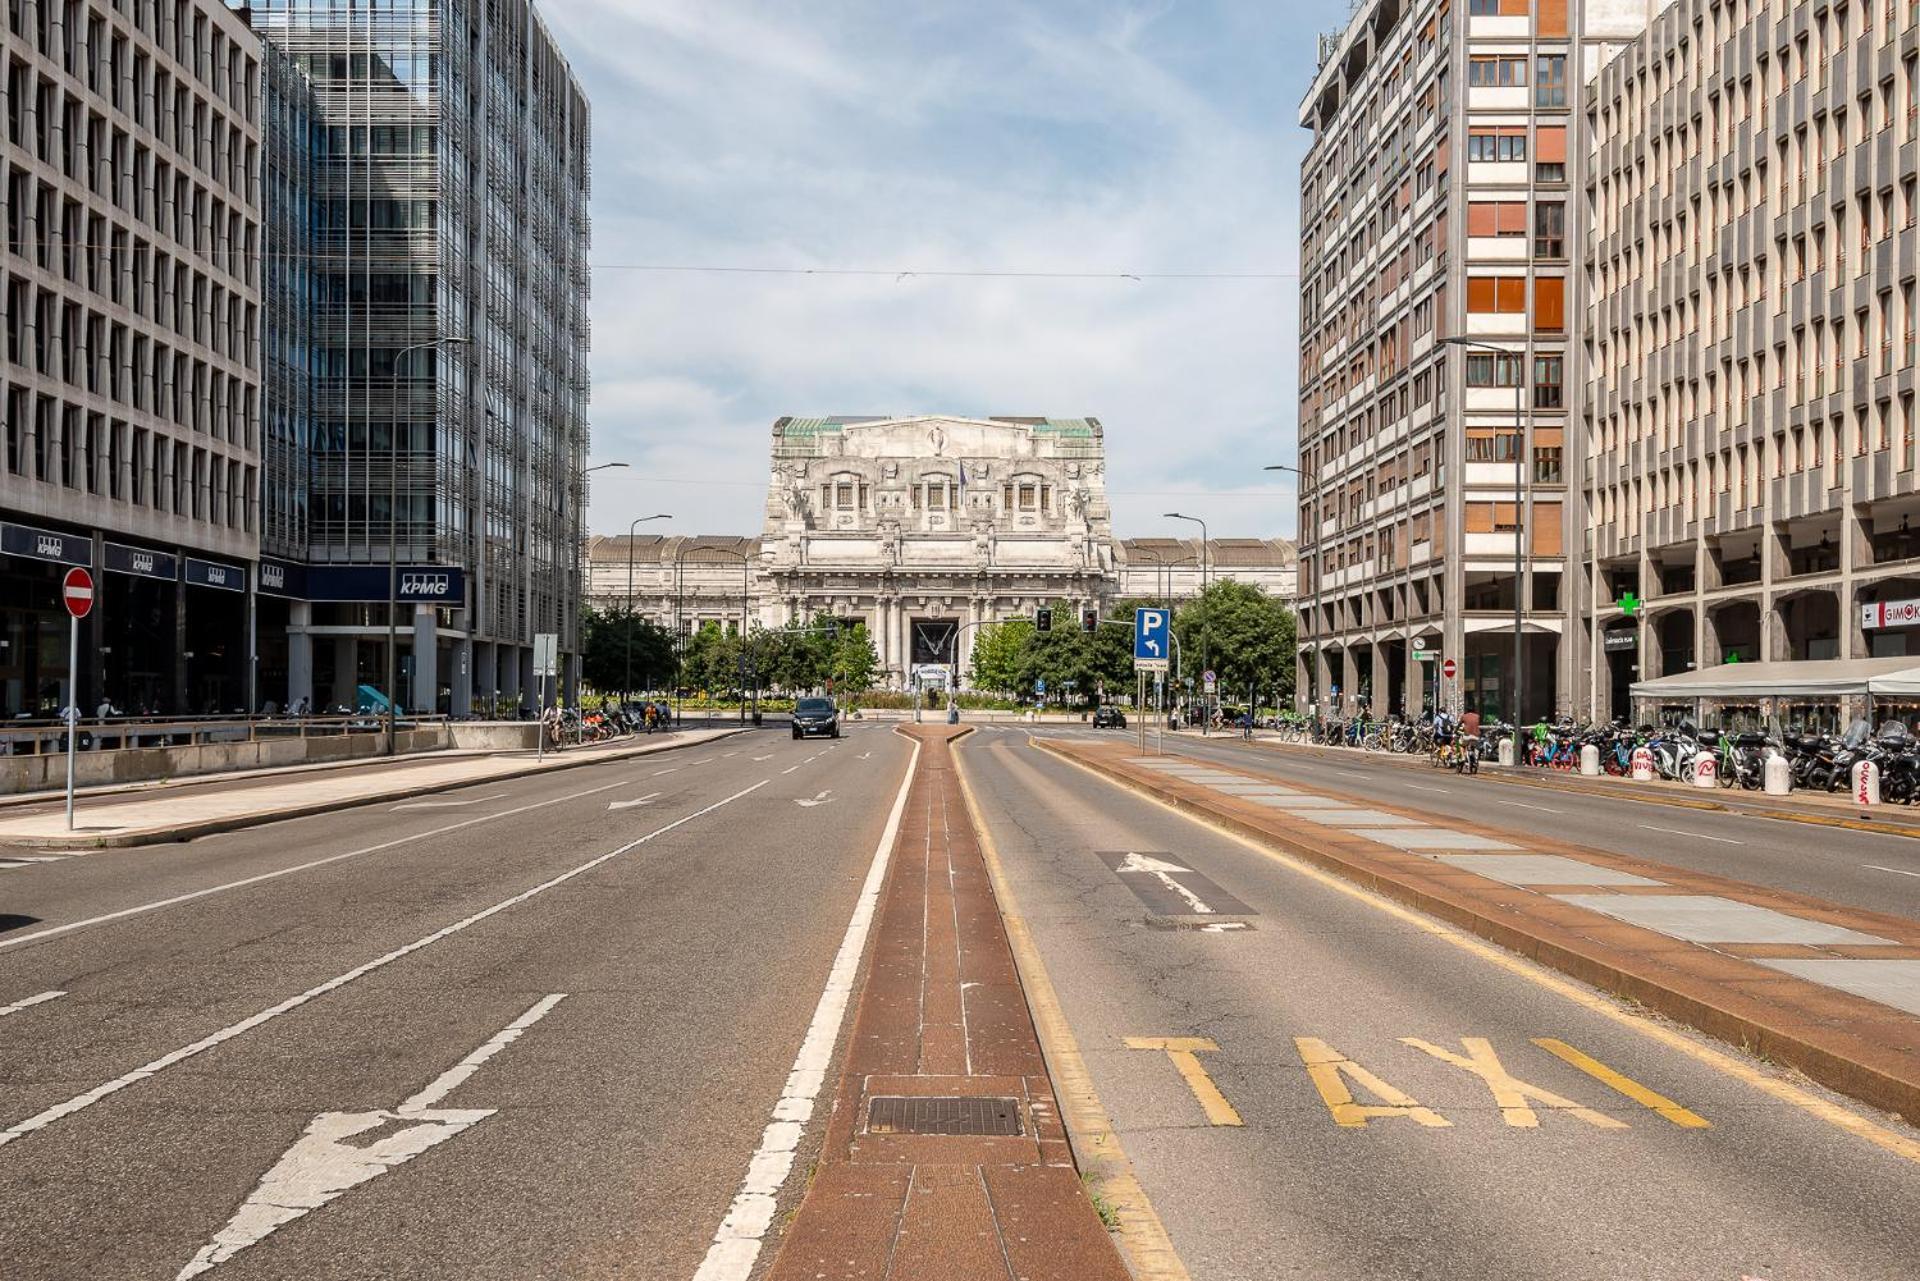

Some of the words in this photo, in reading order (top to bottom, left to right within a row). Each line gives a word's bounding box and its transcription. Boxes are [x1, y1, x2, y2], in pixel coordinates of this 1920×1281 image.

[37, 543, 62, 556] KPMG
[400, 582, 448, 594] KPMG
[1143, 611, 1162, 636] P
[1122, 1037, 1712, 1128] TAXI
